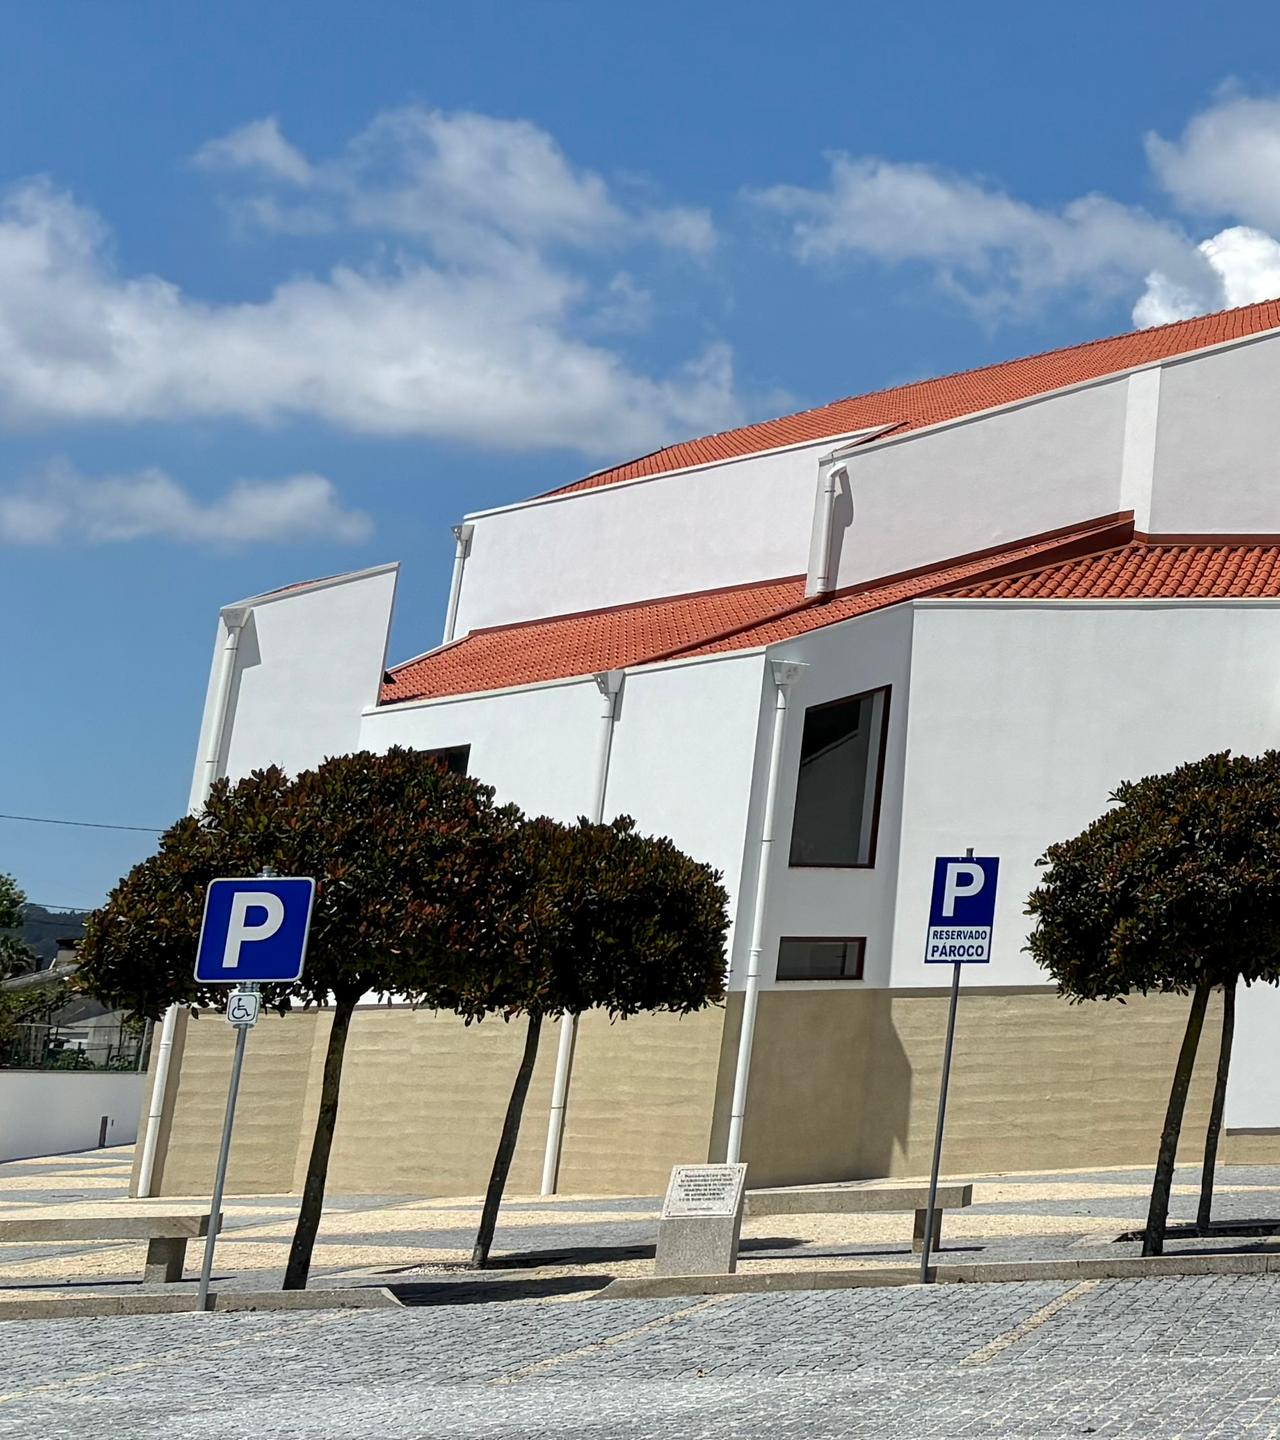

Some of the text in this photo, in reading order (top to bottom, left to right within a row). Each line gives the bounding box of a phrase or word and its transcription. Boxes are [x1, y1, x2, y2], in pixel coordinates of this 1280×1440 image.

[942, 862, 985, 917] P
[222, 892, 284, 968] P
[932, 930, 987, 940] RESERVADO
[931, 942, 984, 957] PÁROCO
